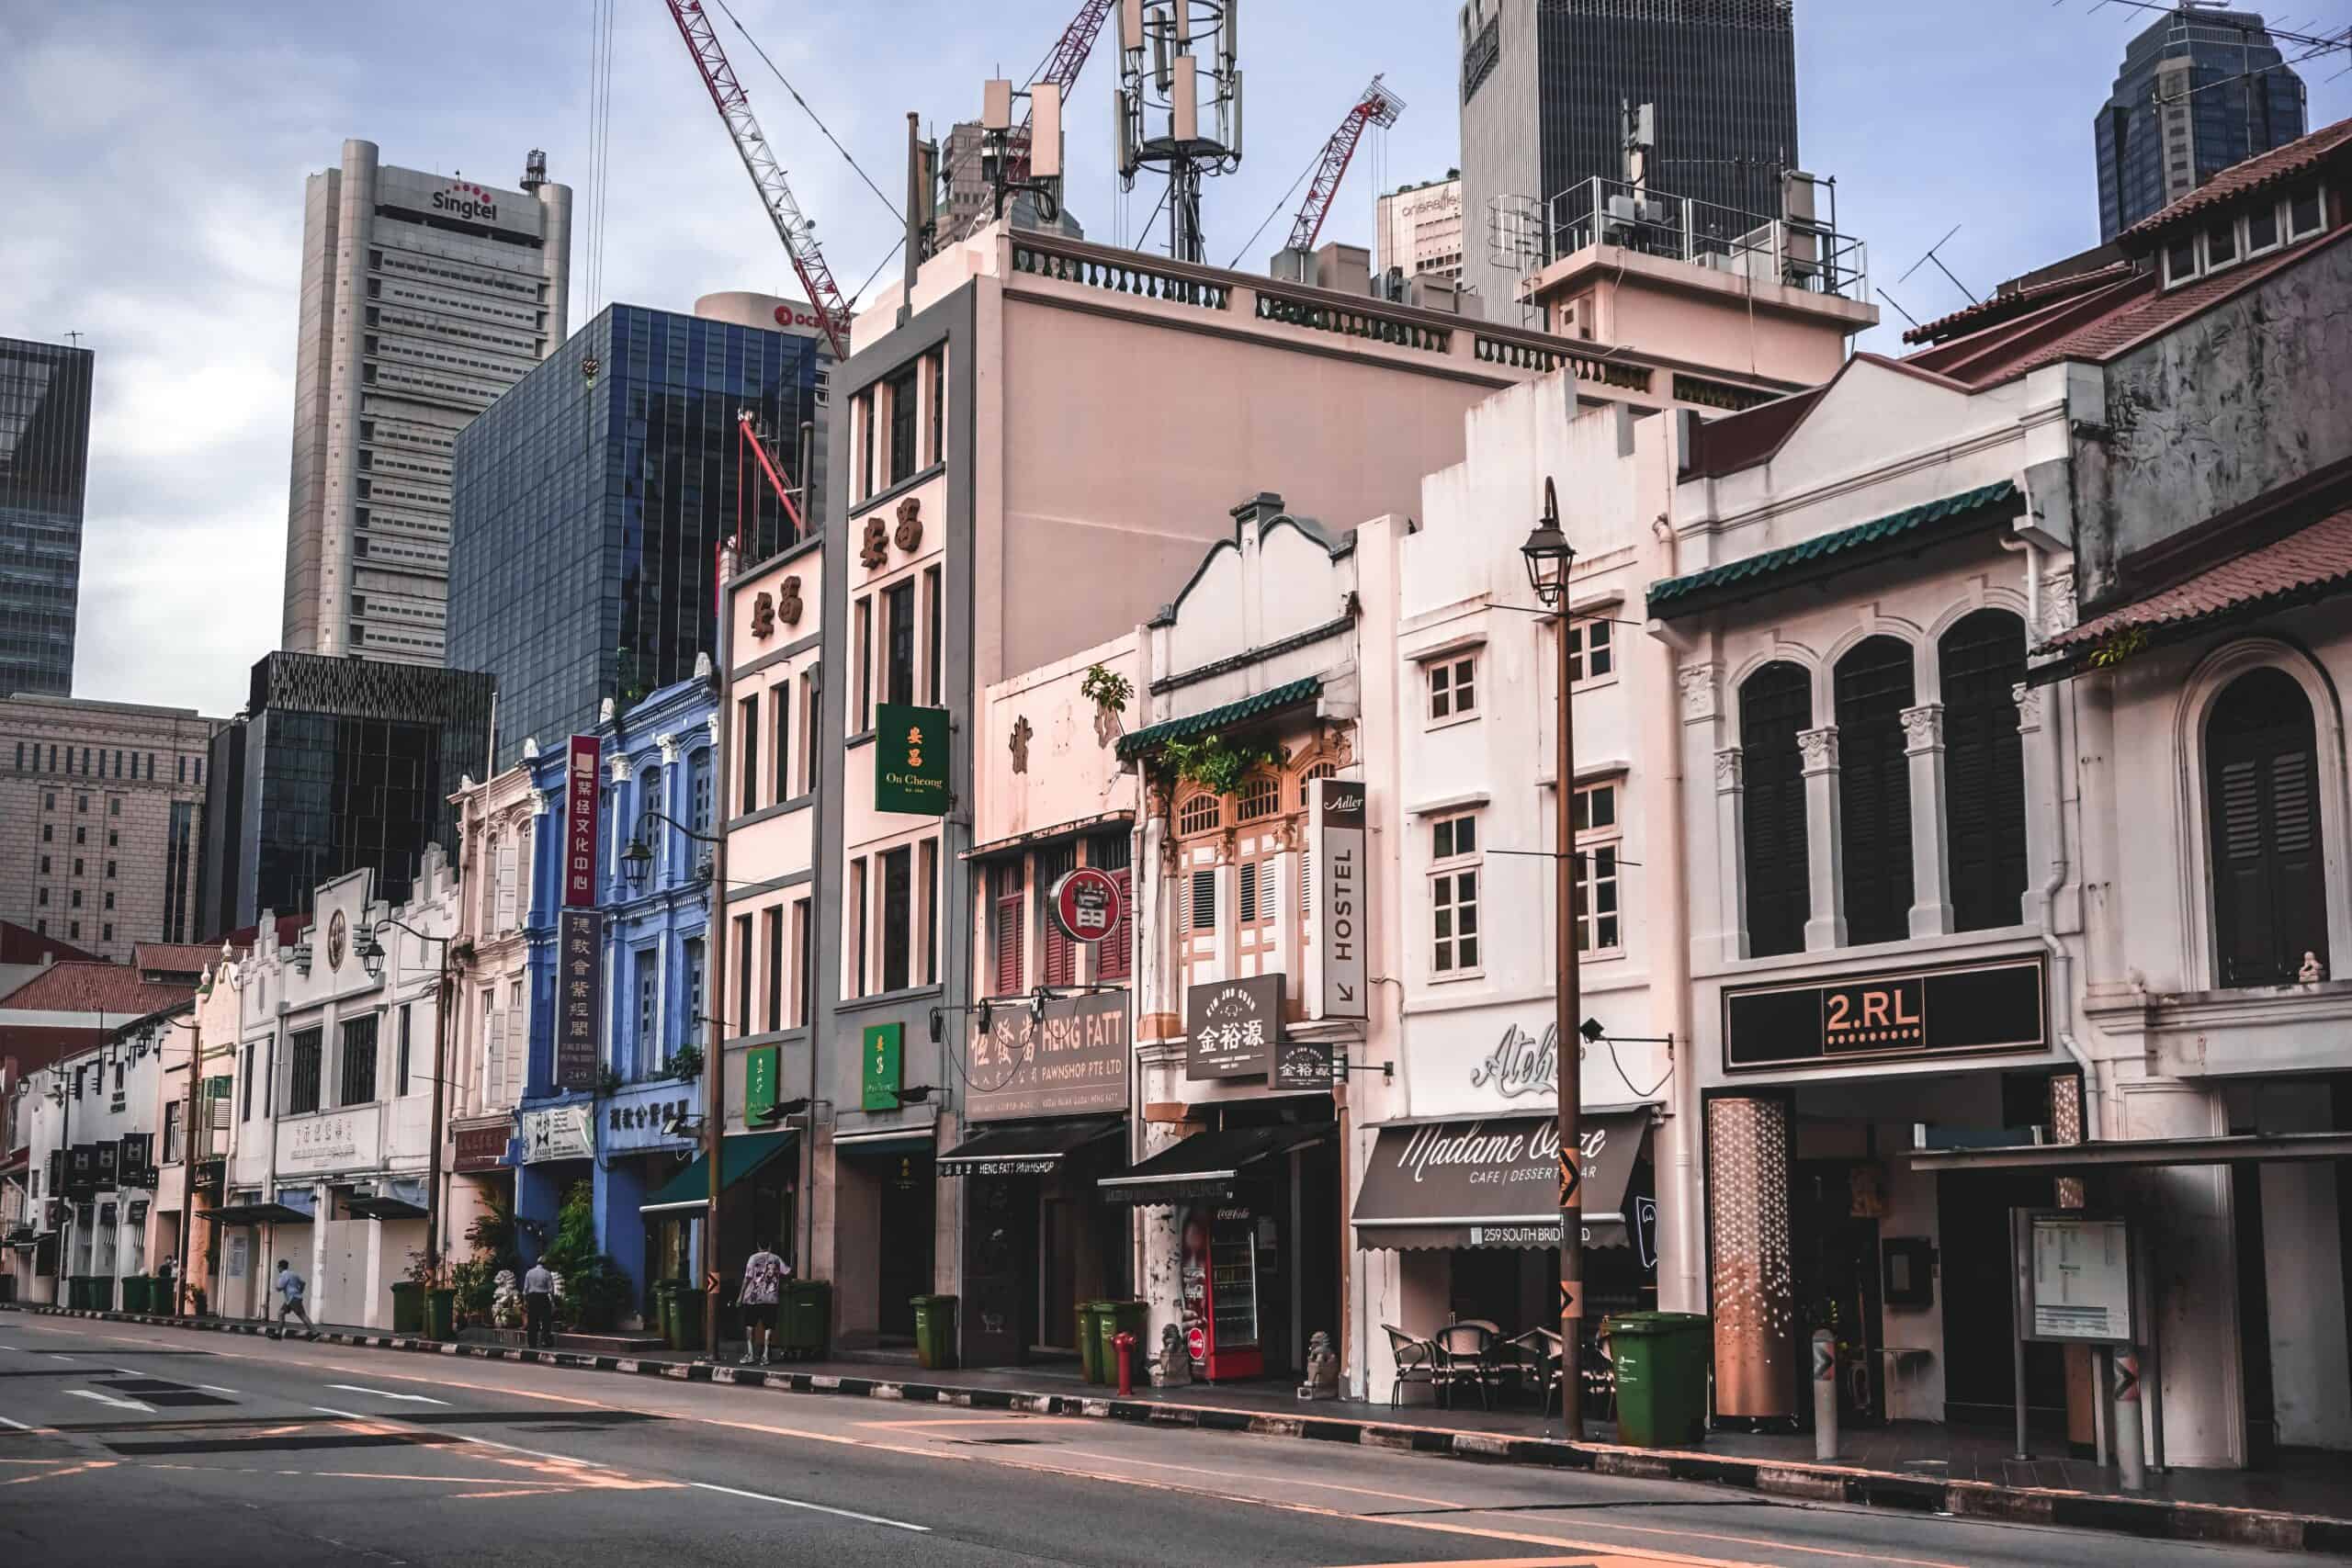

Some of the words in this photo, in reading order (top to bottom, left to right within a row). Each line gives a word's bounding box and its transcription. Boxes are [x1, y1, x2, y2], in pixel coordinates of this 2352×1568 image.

[433, 189, 497, 220] Singtel
[886, 773, 902, 784] On
[904, 773, 942, 788] Cheong
[1324, 794, 1363, 812] Adler
[573, 782, 592, 890] 紫经文化中心
[1335, 850, 1352, 961] HOSTEL
[1827, 988, 1920, 1031] 2.RL
[1042, 1015, 1080, 1052] HENG
[1086, 1010, 1123, 1047] FATT
[1196, 1020, 1265, 1054] 金裕源
[1042, 1062, 1086, 1081] PAWNSHOP
[1089, 1060, 1103, 1077] PTE
[1106, 1058, 1122, 1076] LTD
[1470, 1021, 1587, 1099] Ateli
[979, 1164, 998, 1175] HENG
[999, 1162, 1015, 1175] FATT
[1015, 1161, 1055, 1174] PAWNSHOP
[1397, 1122, 1523, 1182] Madame
[1470, 1169, 1500, 1184] CAFE
[1484, 1228, 1501, 1242] 259
[1502, 1227, 1537, 1242] SOUTH
